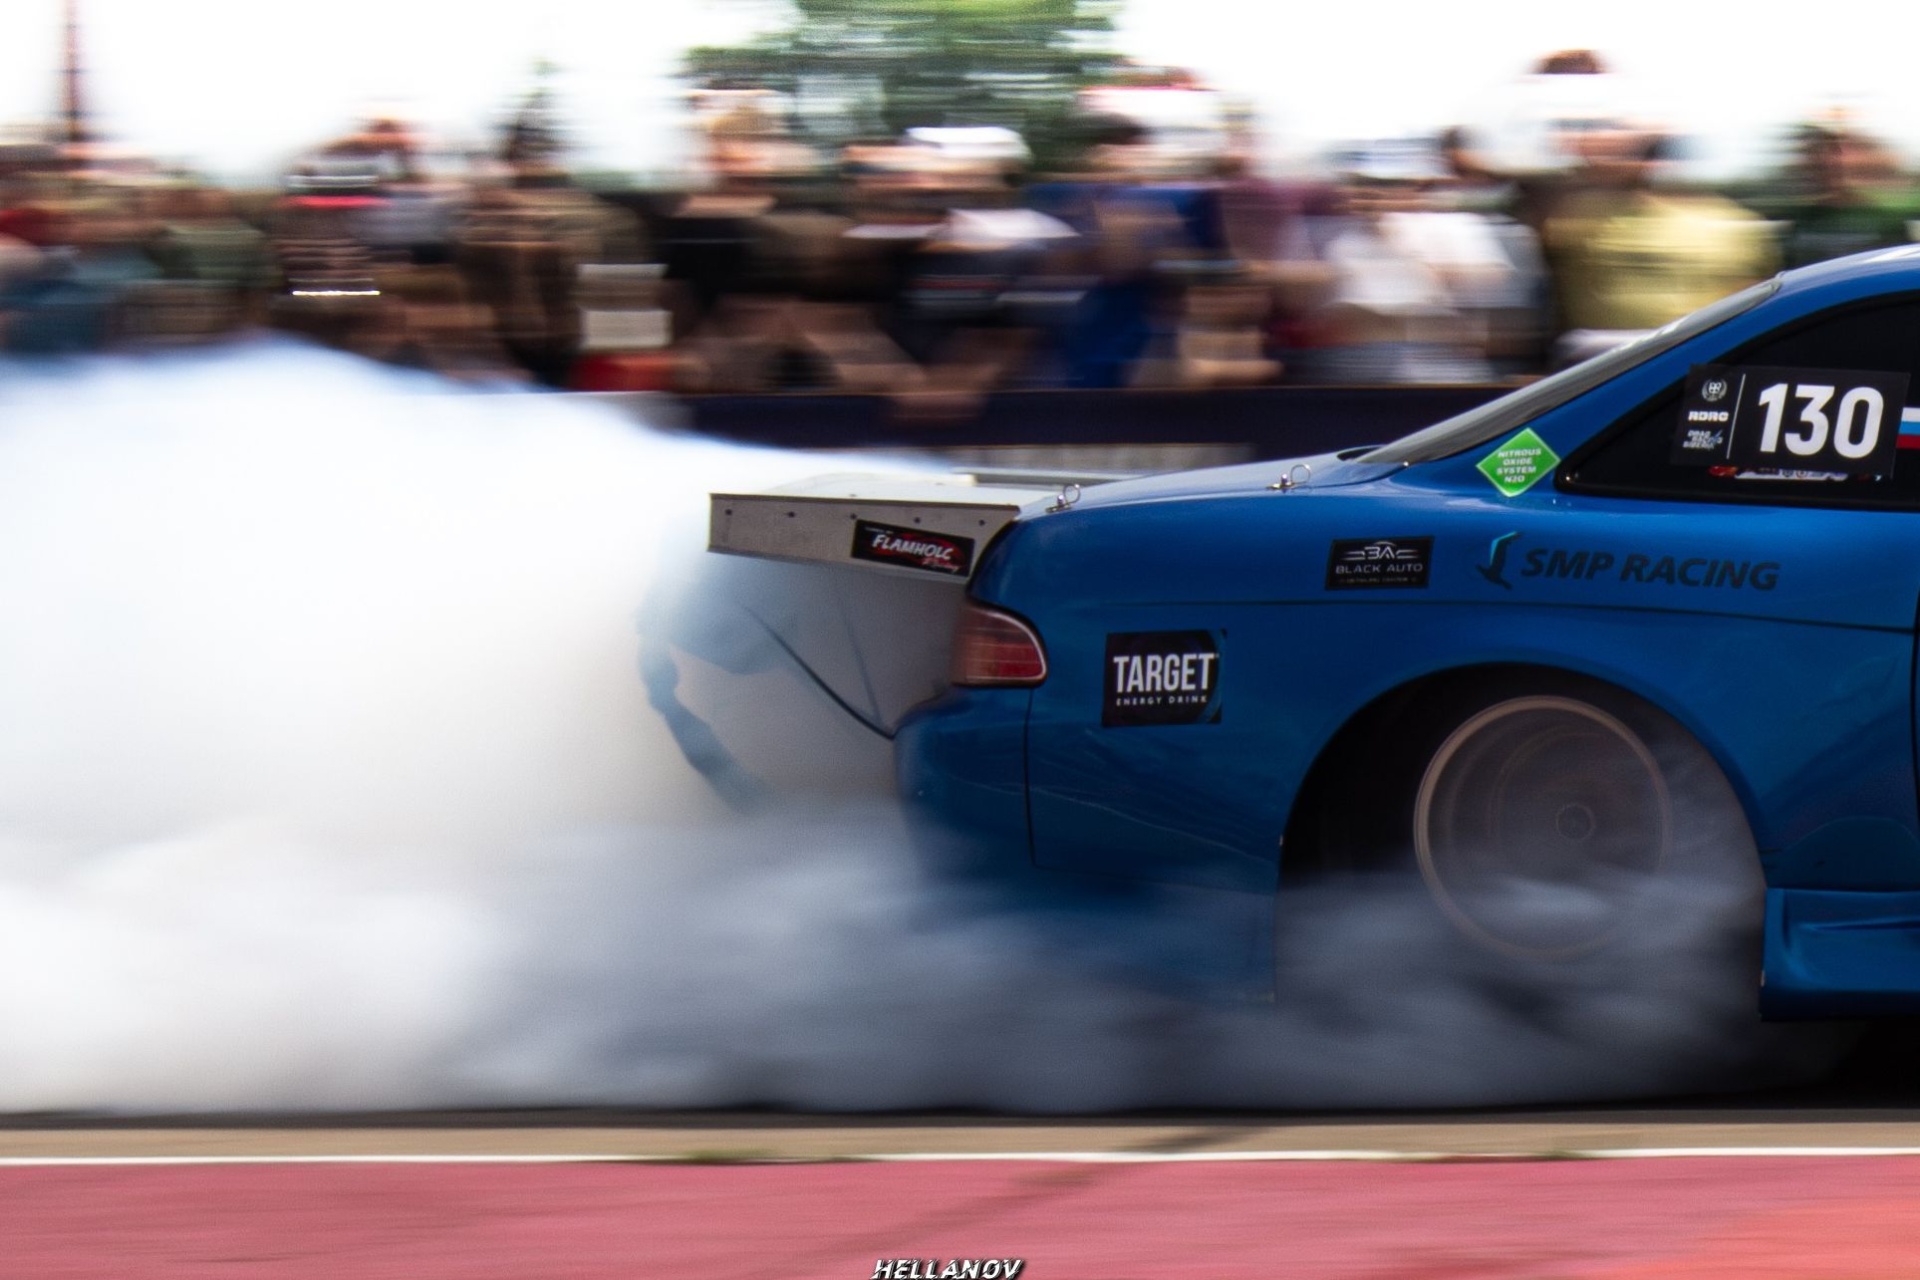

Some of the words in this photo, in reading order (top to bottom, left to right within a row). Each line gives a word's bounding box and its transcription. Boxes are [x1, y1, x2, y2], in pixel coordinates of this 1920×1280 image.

[1758, 383, 1884, 459] 130
[1498, 448, 1541, 457] NITROUS
[1503, 457, 1532, 465] OXIDE
[1496, 466, 1536, 475] SYSTEM
[1335, 564, 1381, 575] BLACK
[1387, 563, 1423, 573] AUTO
[1521, 549, 1614, 580] SMP
[1620, 553, 1779, 591] RACING
[1113, 653, 1215, 693] TARGET
[1116, 697, 1162, 706] ENERGY
[1168, 695, 1208, 704] DRINK
